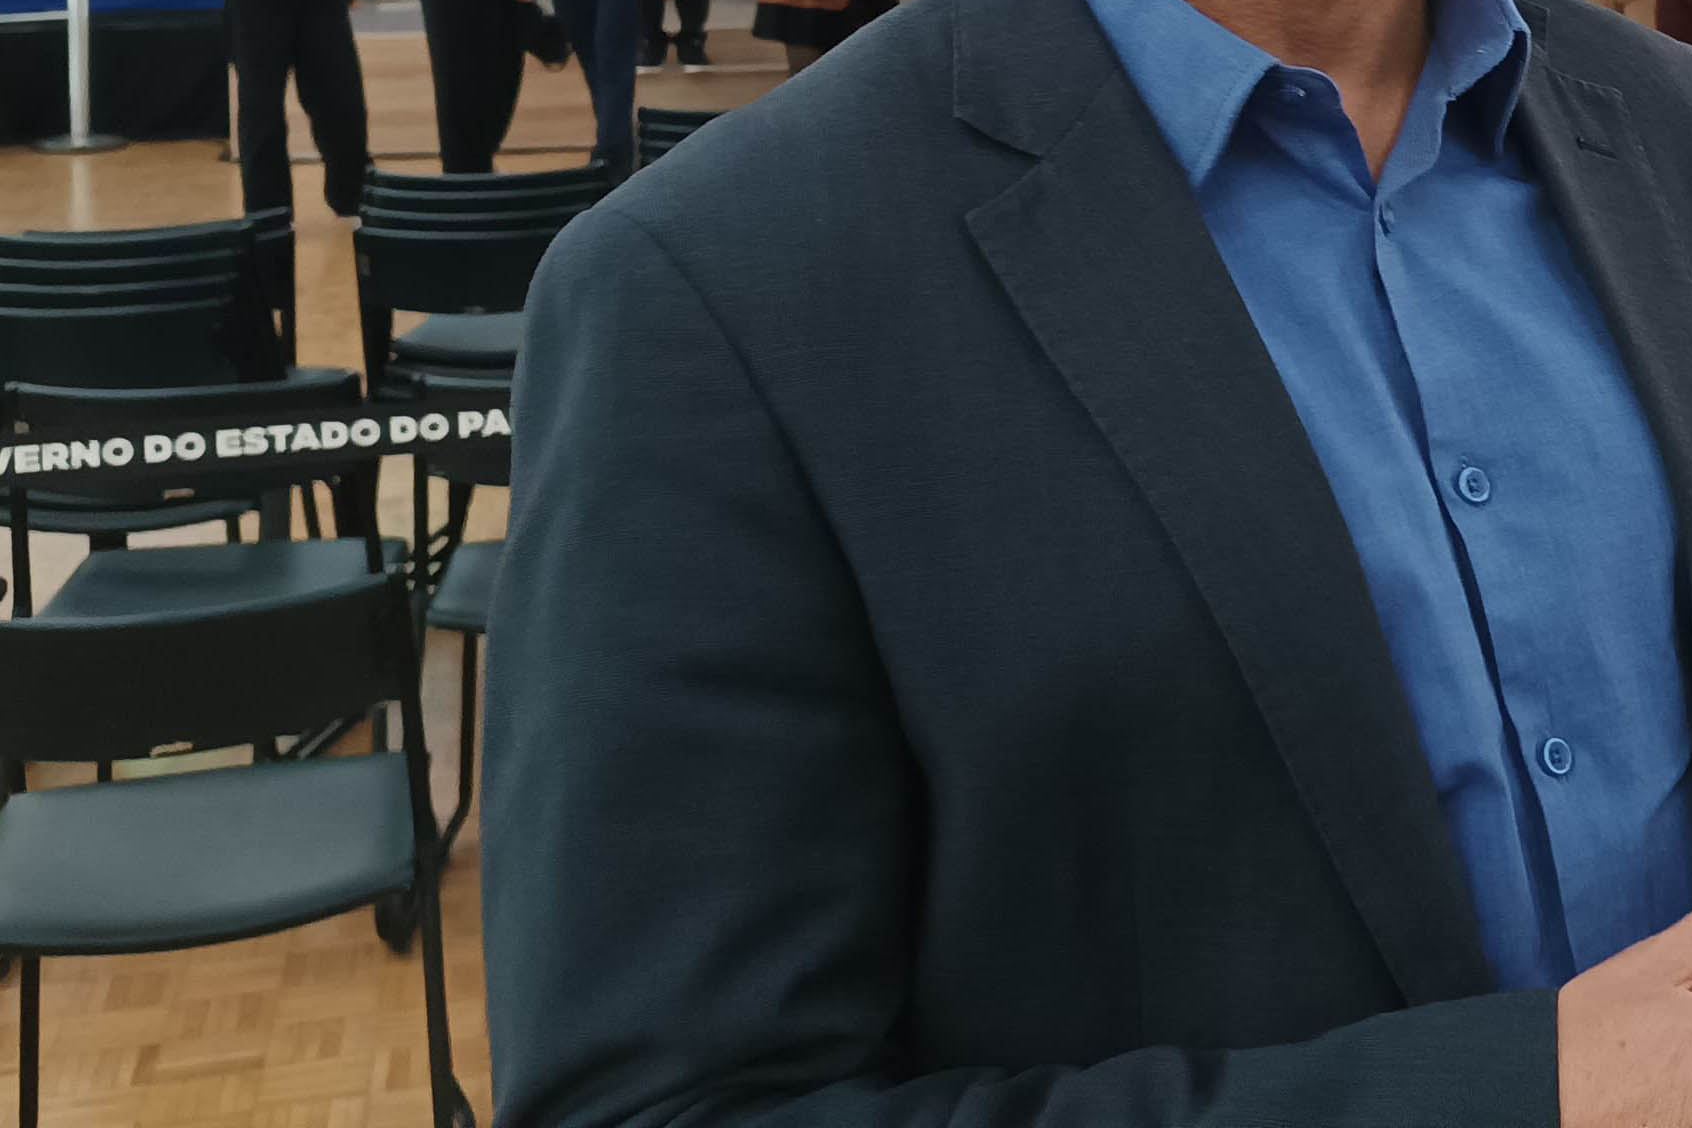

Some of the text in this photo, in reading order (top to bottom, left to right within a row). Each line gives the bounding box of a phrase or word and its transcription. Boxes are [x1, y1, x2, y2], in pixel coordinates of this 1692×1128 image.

[144, 432, 206, 464] DO
[216, 418, 381, 458] ESTADO
[390, 413, 450, 443] DO
[457, 408, 512, 439] PA
